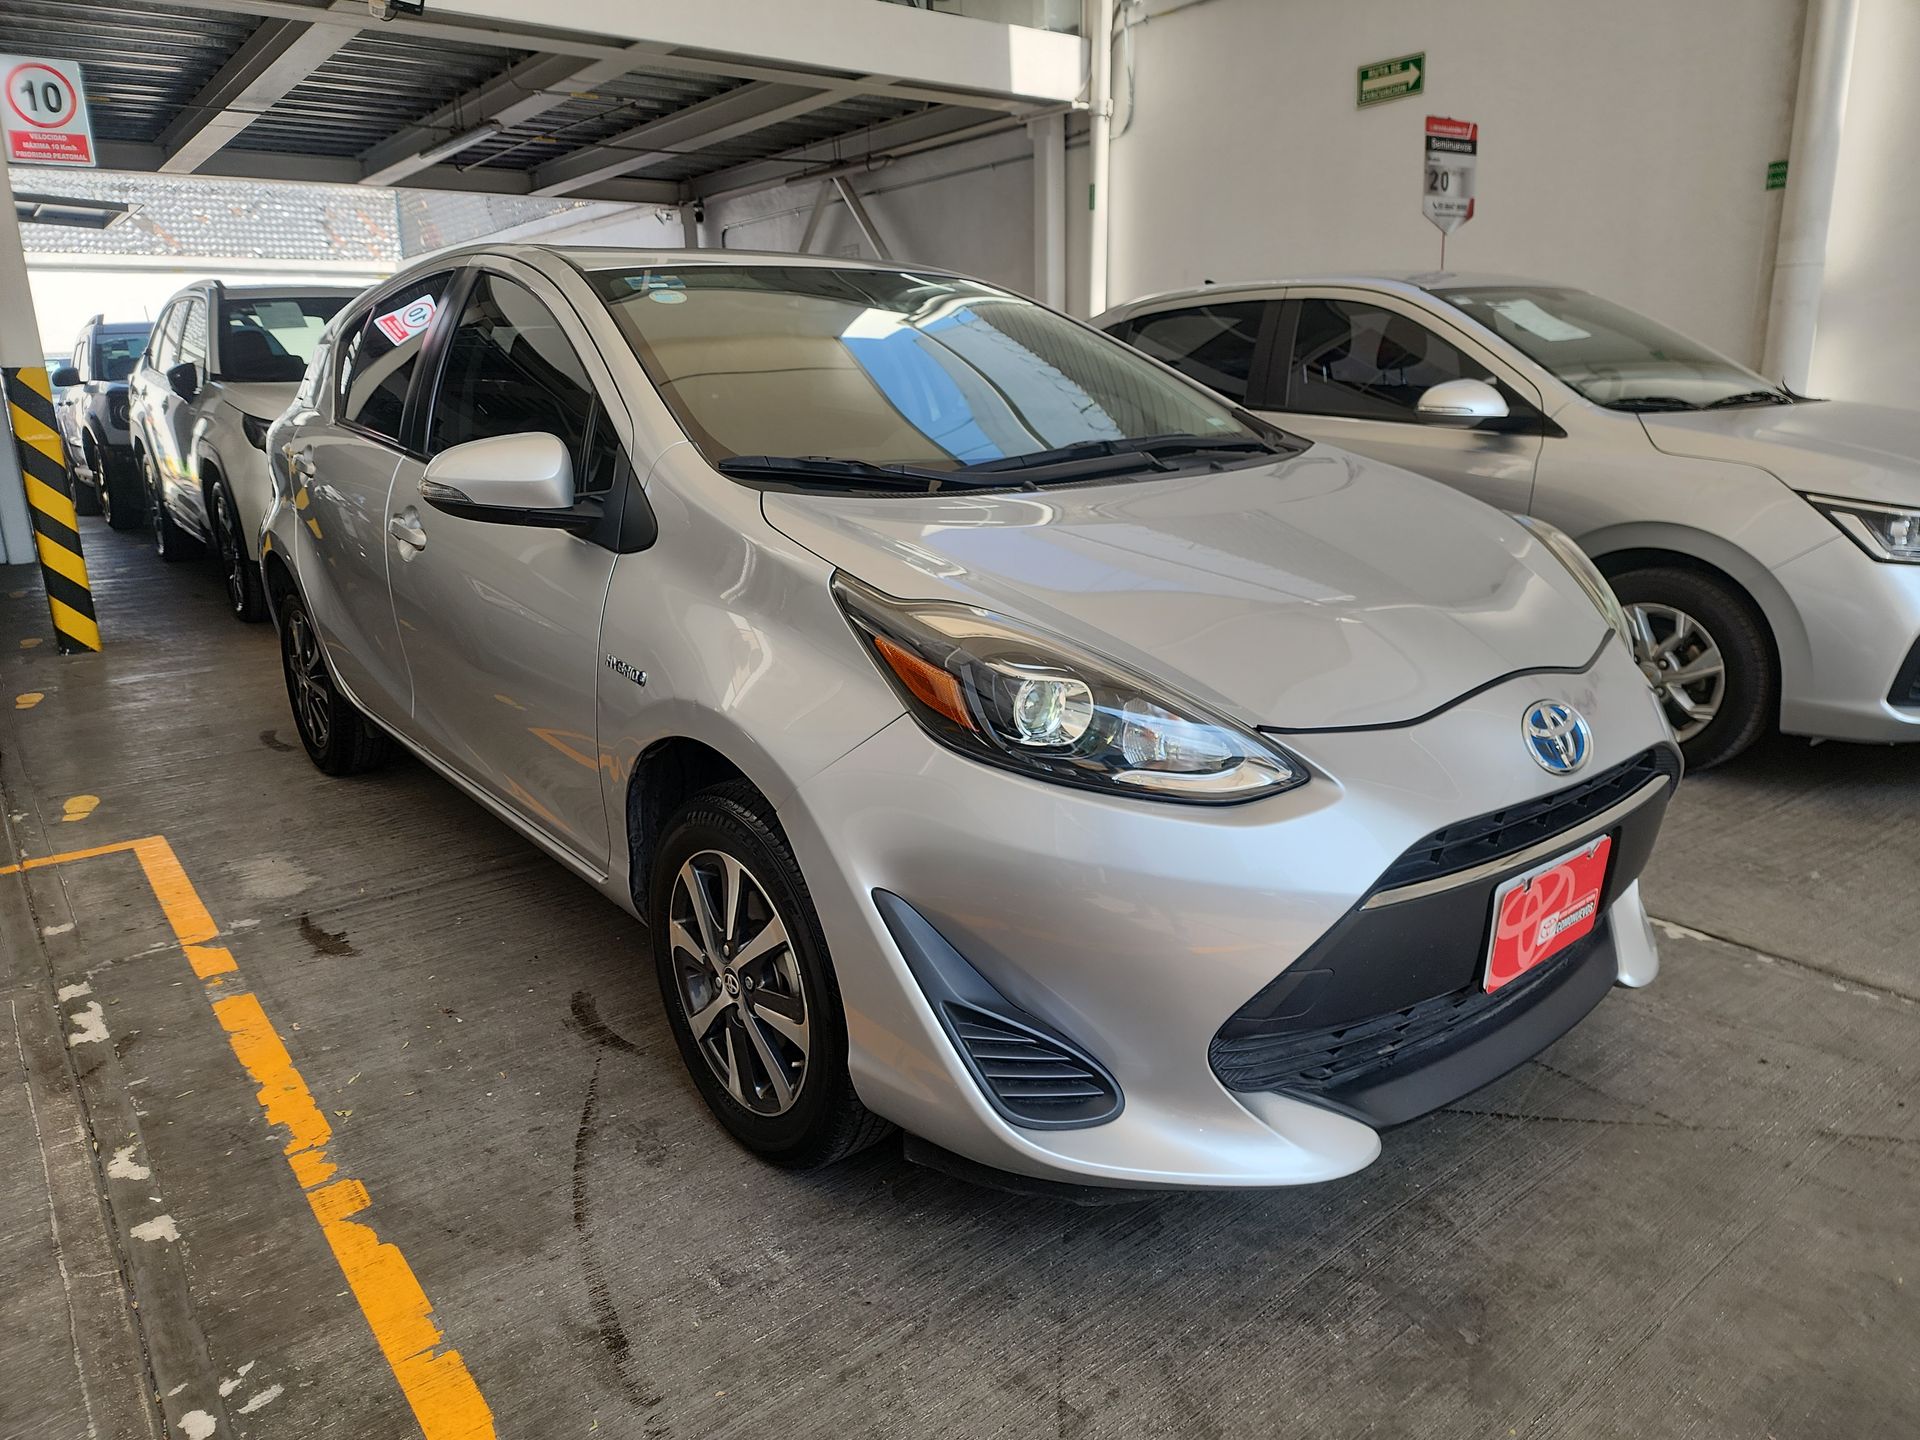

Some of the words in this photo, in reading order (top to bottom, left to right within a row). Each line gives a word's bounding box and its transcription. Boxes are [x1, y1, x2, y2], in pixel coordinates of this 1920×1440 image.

[21, 80, 62, 113] 10
[29, 133, 67, 142] VELOCIDAD
[16, 150, 52, 159] PRIORIDAD
[53, 152, 87, 161] PEATONAL
[1429, 169, 1449, 192] 20
